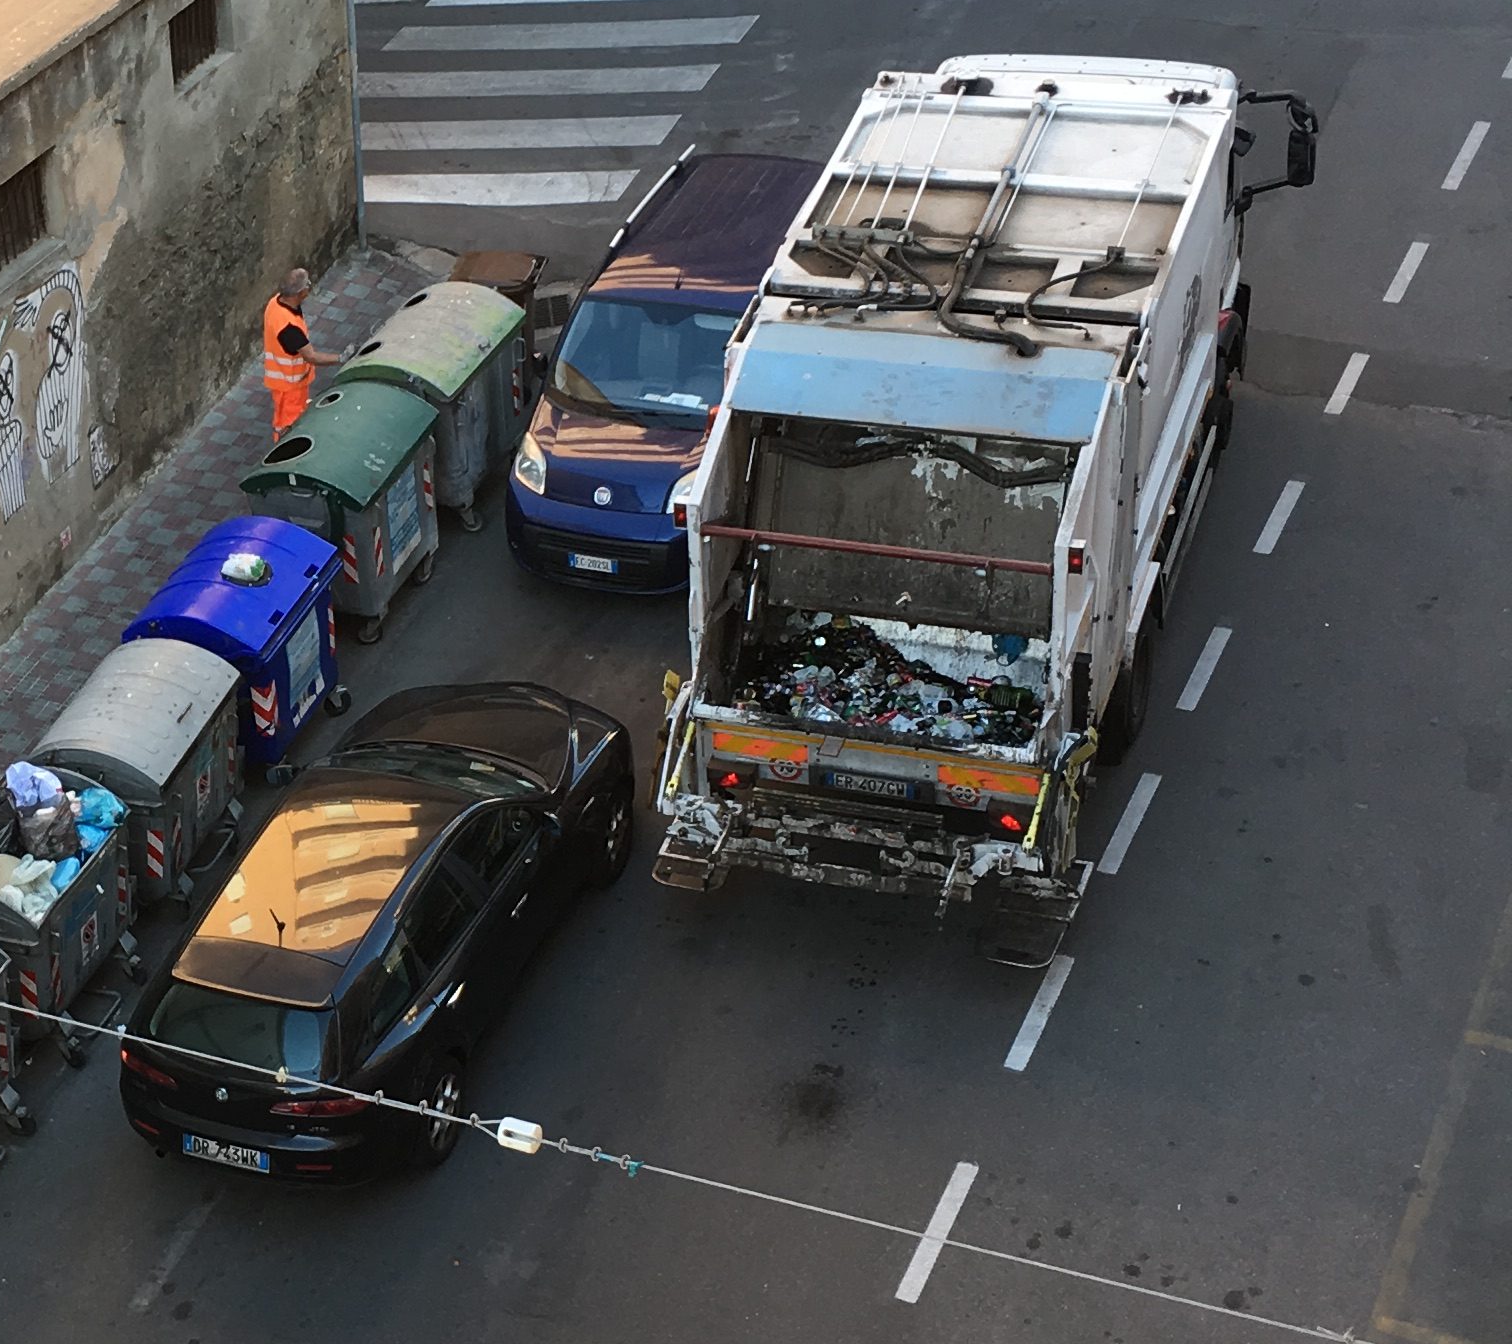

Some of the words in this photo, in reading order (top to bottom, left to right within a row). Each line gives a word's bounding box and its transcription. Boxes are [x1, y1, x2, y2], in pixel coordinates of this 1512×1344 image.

[835, 773, 854, 789] ER
[859, 777, 907, 798] 407GW
[193, 1136, 210, 1155] DR
